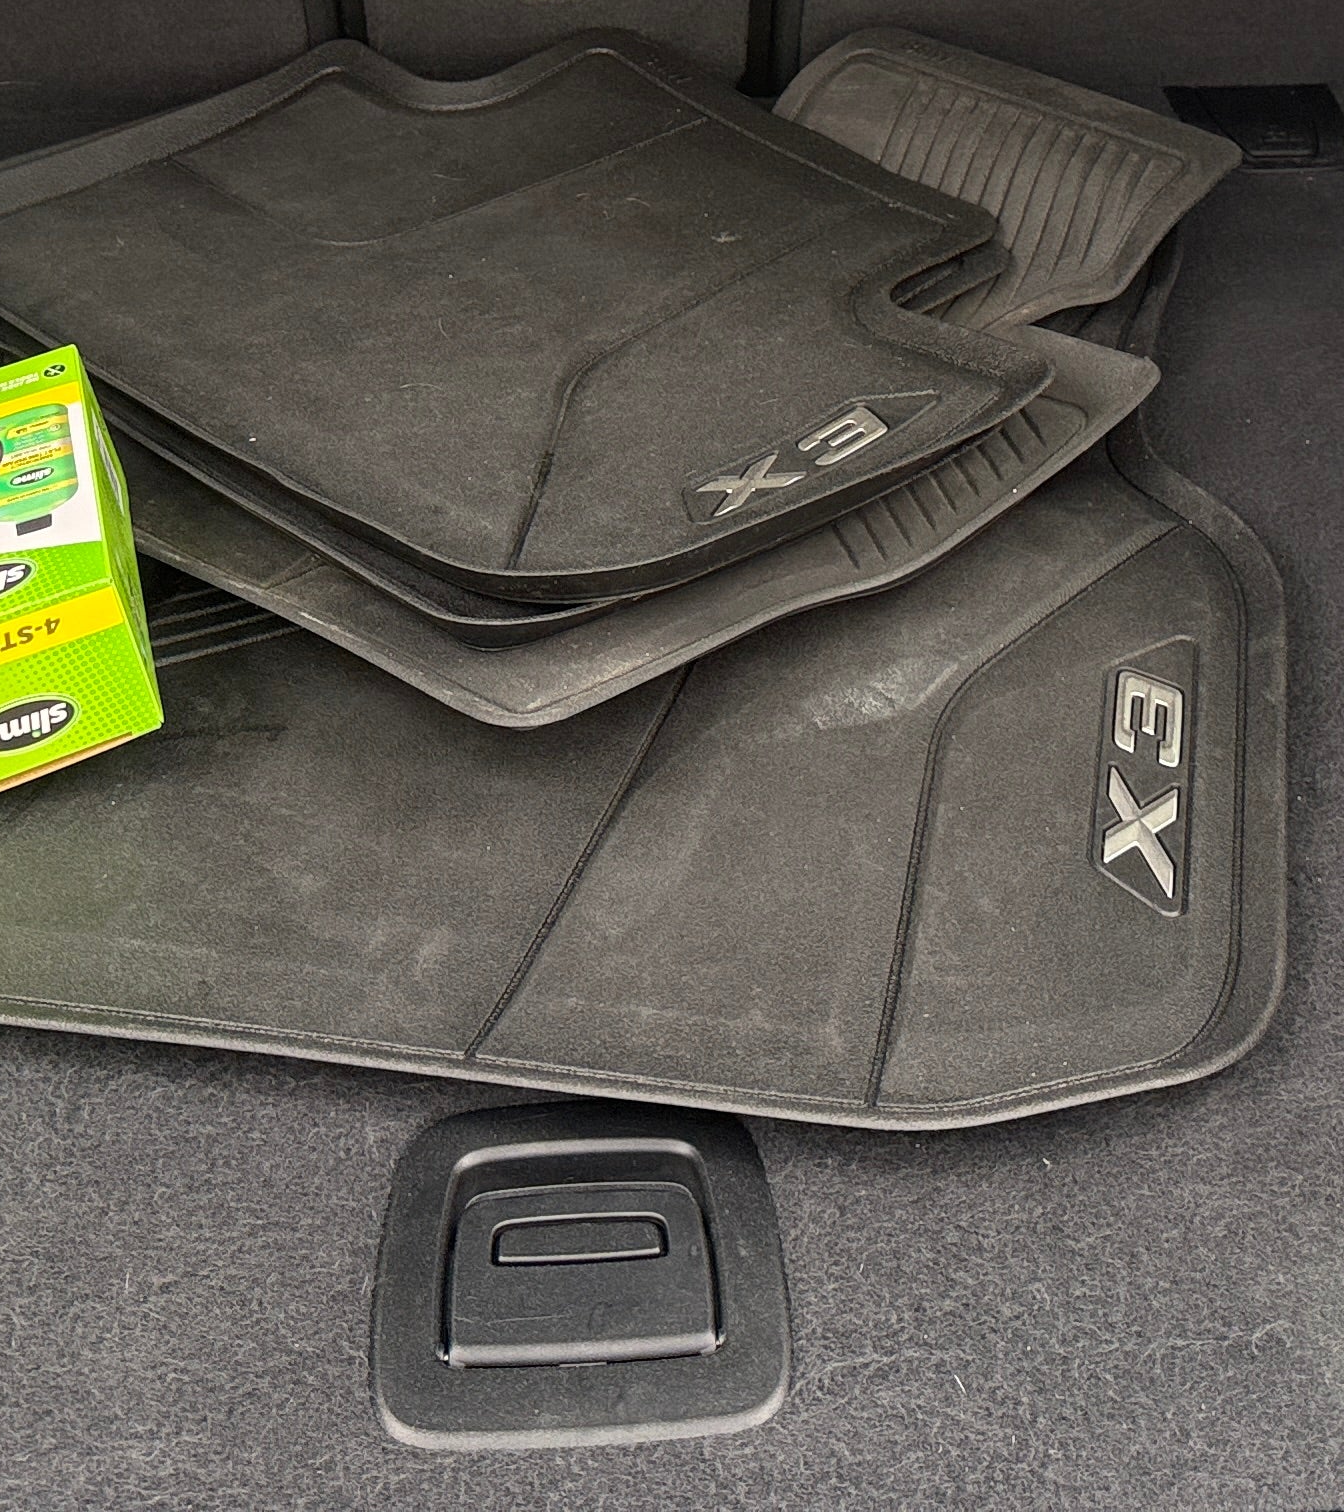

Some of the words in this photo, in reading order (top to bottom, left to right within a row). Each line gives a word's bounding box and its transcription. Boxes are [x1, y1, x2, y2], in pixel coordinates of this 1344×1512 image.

[11, 467, 52, 486] slime
[696, 405, 888, 517] X3
[1103, 666, 1183, 899] X3
